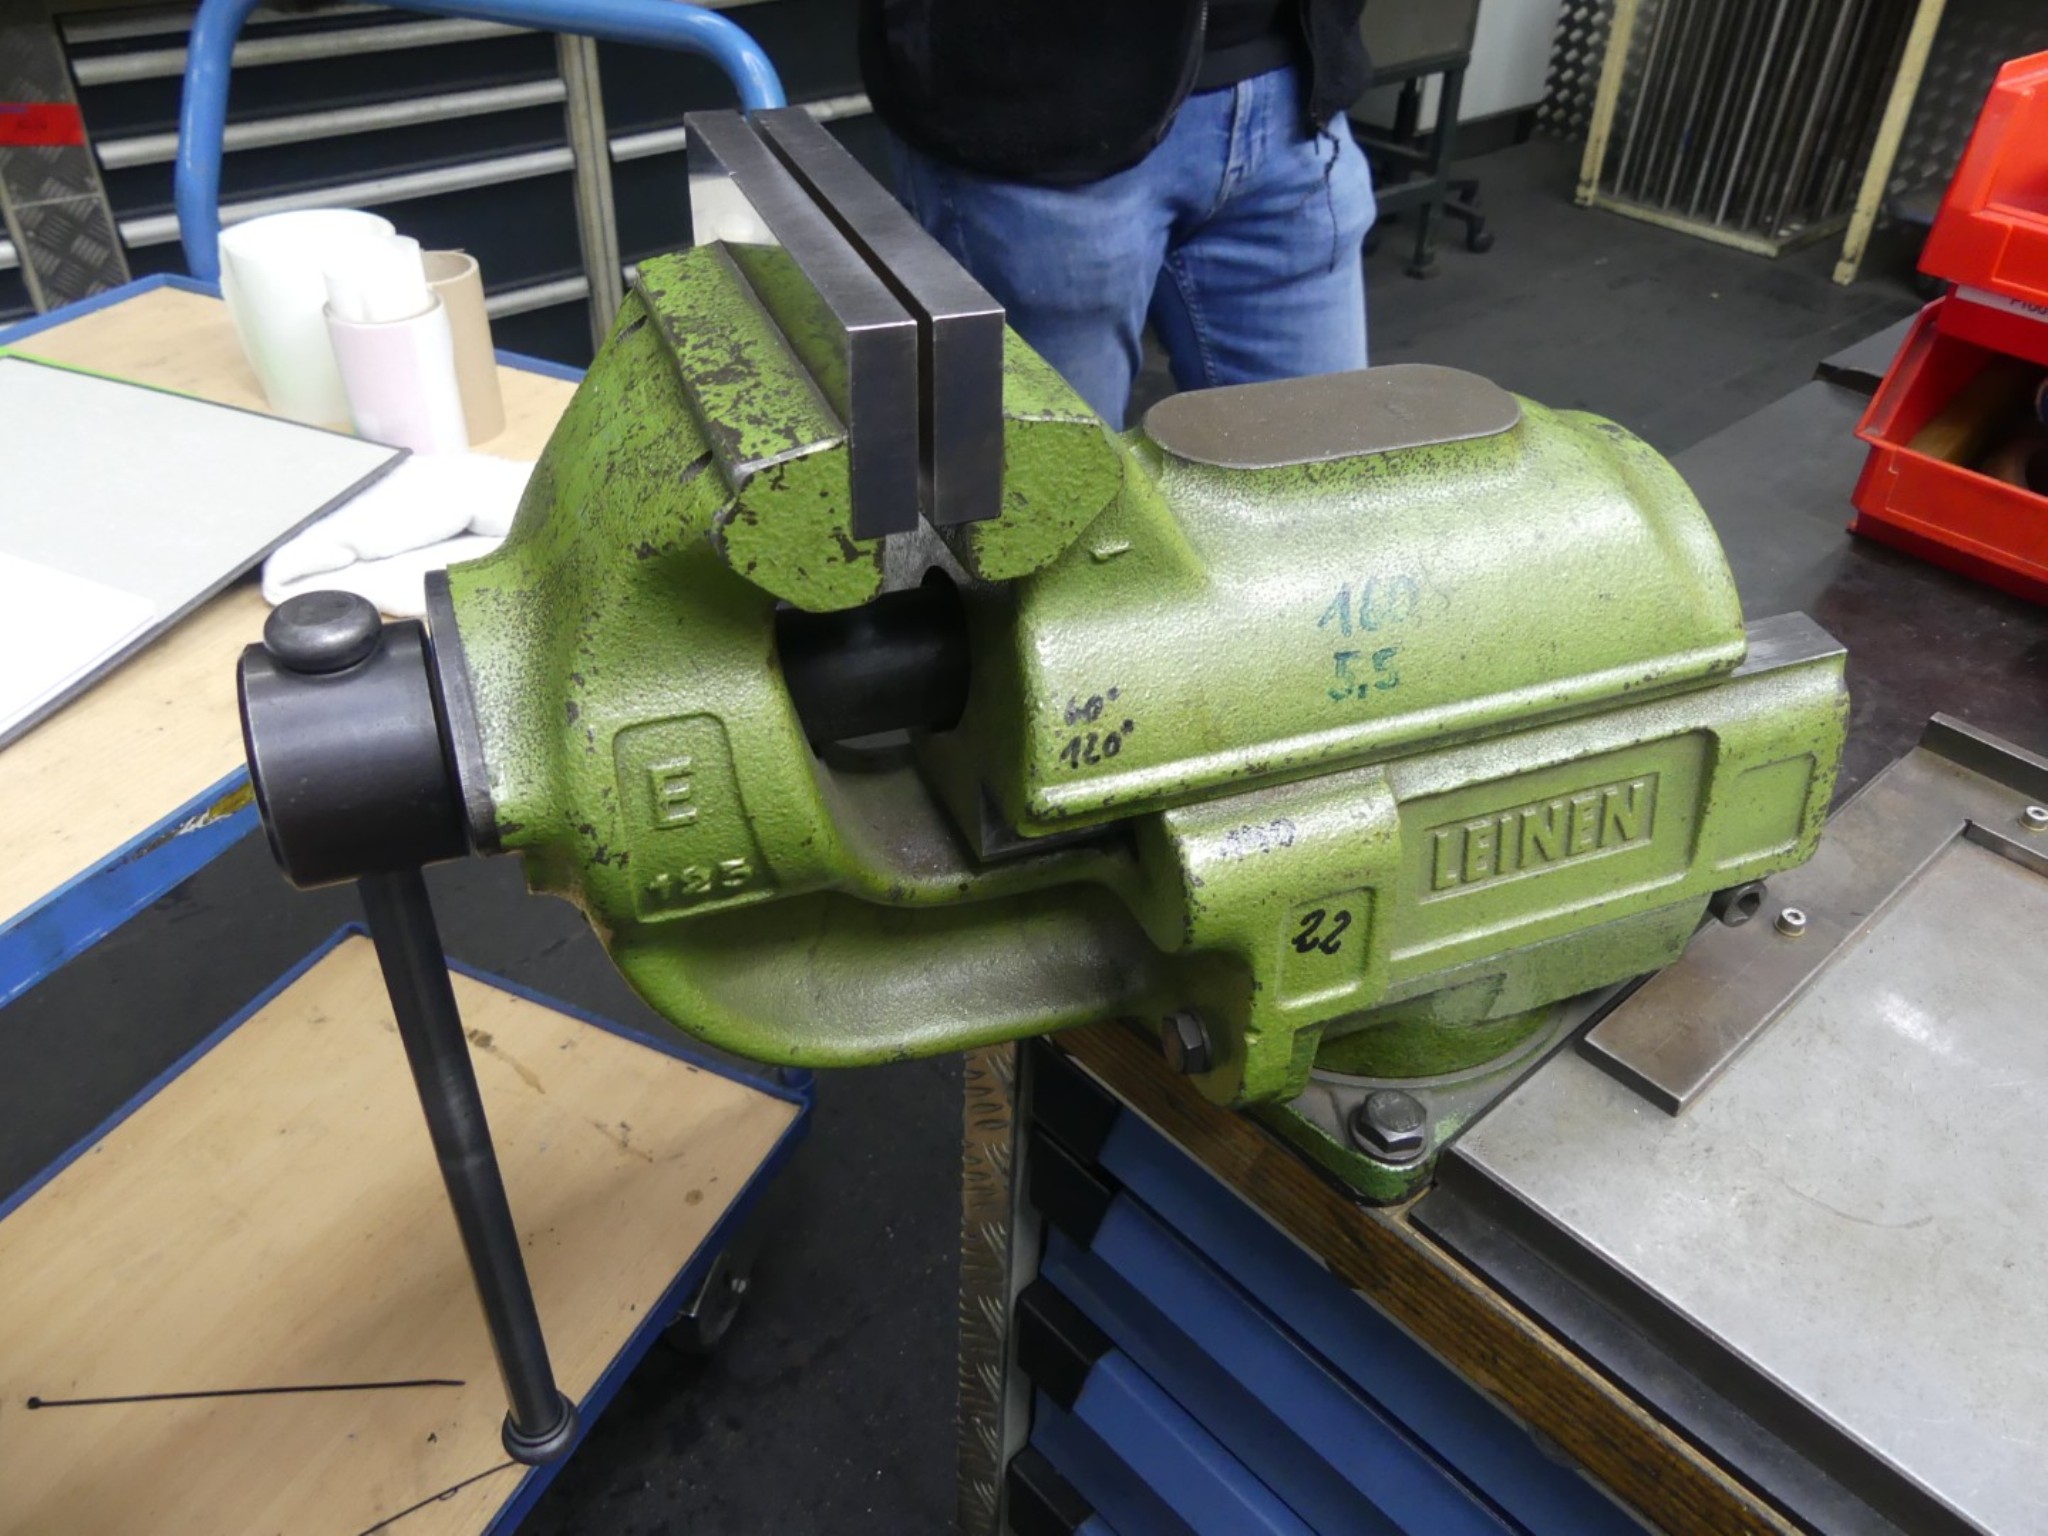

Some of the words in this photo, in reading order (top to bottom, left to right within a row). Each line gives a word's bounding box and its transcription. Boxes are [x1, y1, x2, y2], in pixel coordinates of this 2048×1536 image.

[1060, 718, 1134, 770] 120°
[648, 756, 698, 830] E
[1431, 781, 1646, 891] LEINEN
[650, 857, 753, 899] 125
[1291, 908, 1352, 955] 22
